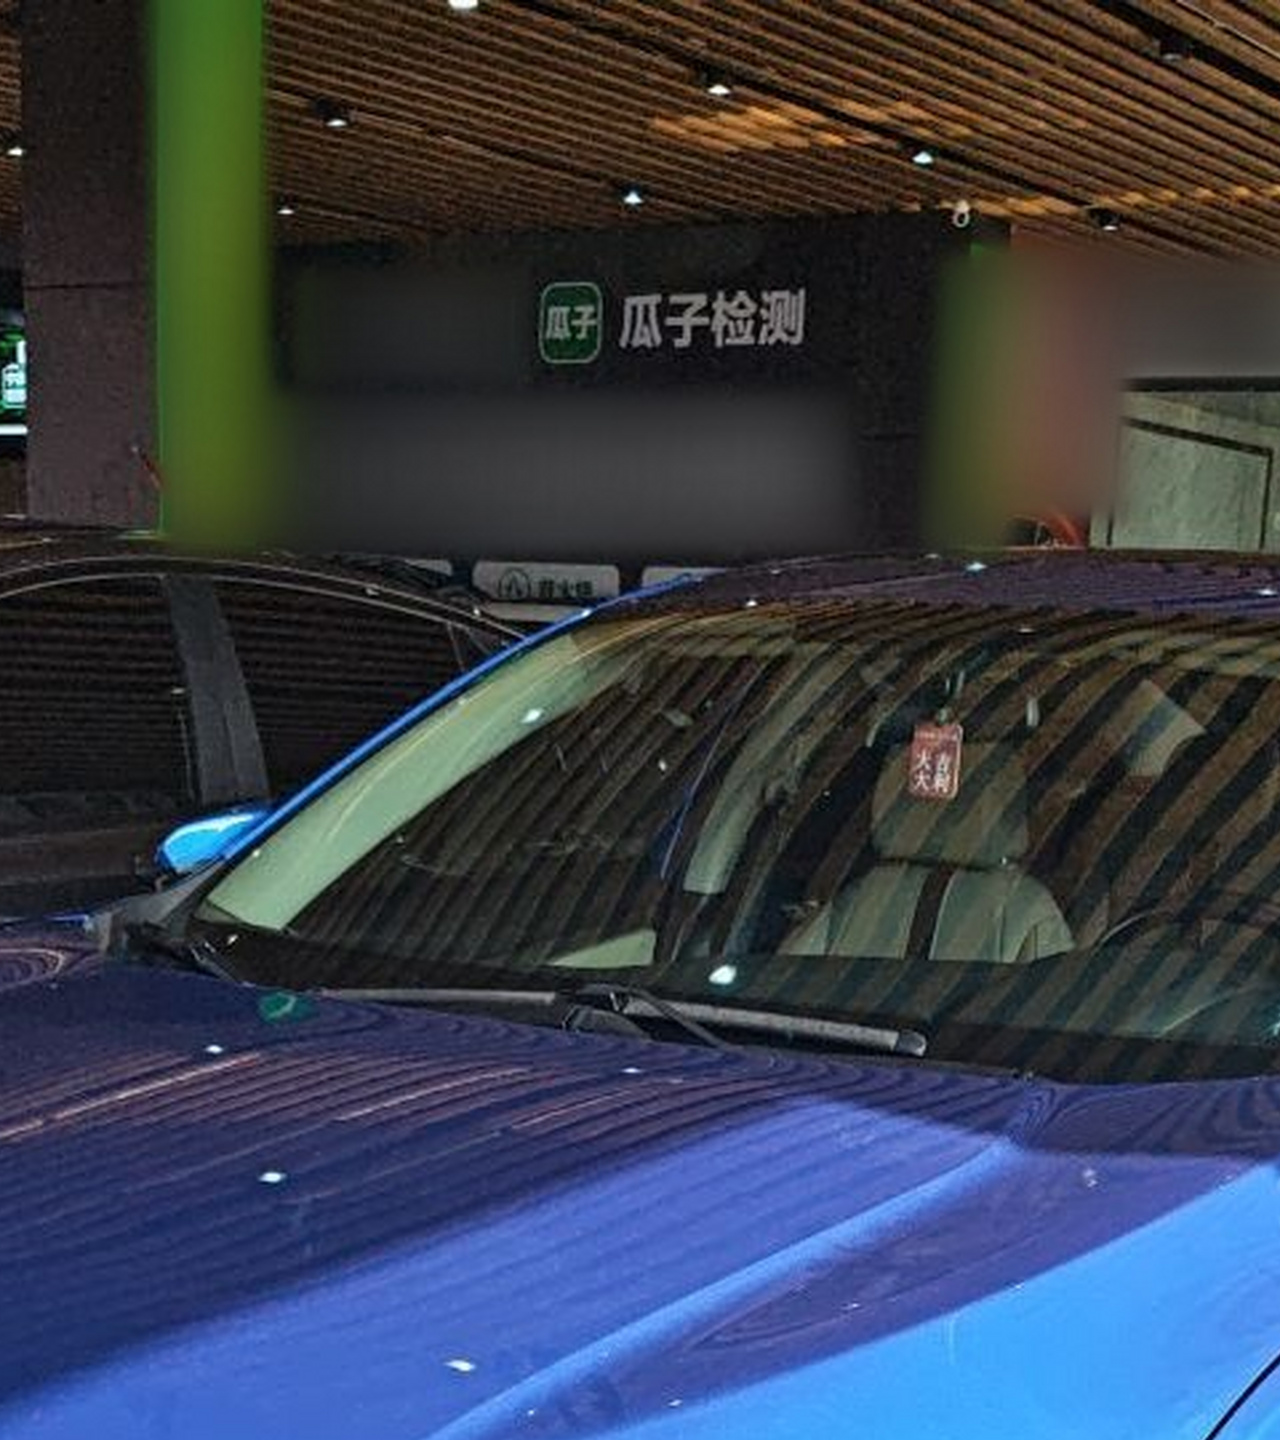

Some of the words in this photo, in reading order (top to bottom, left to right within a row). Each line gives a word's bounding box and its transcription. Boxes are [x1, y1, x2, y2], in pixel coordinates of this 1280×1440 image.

[546, 305, 597, 340] 瓜子
[619, 288, 806, 349] 瓜子检测
